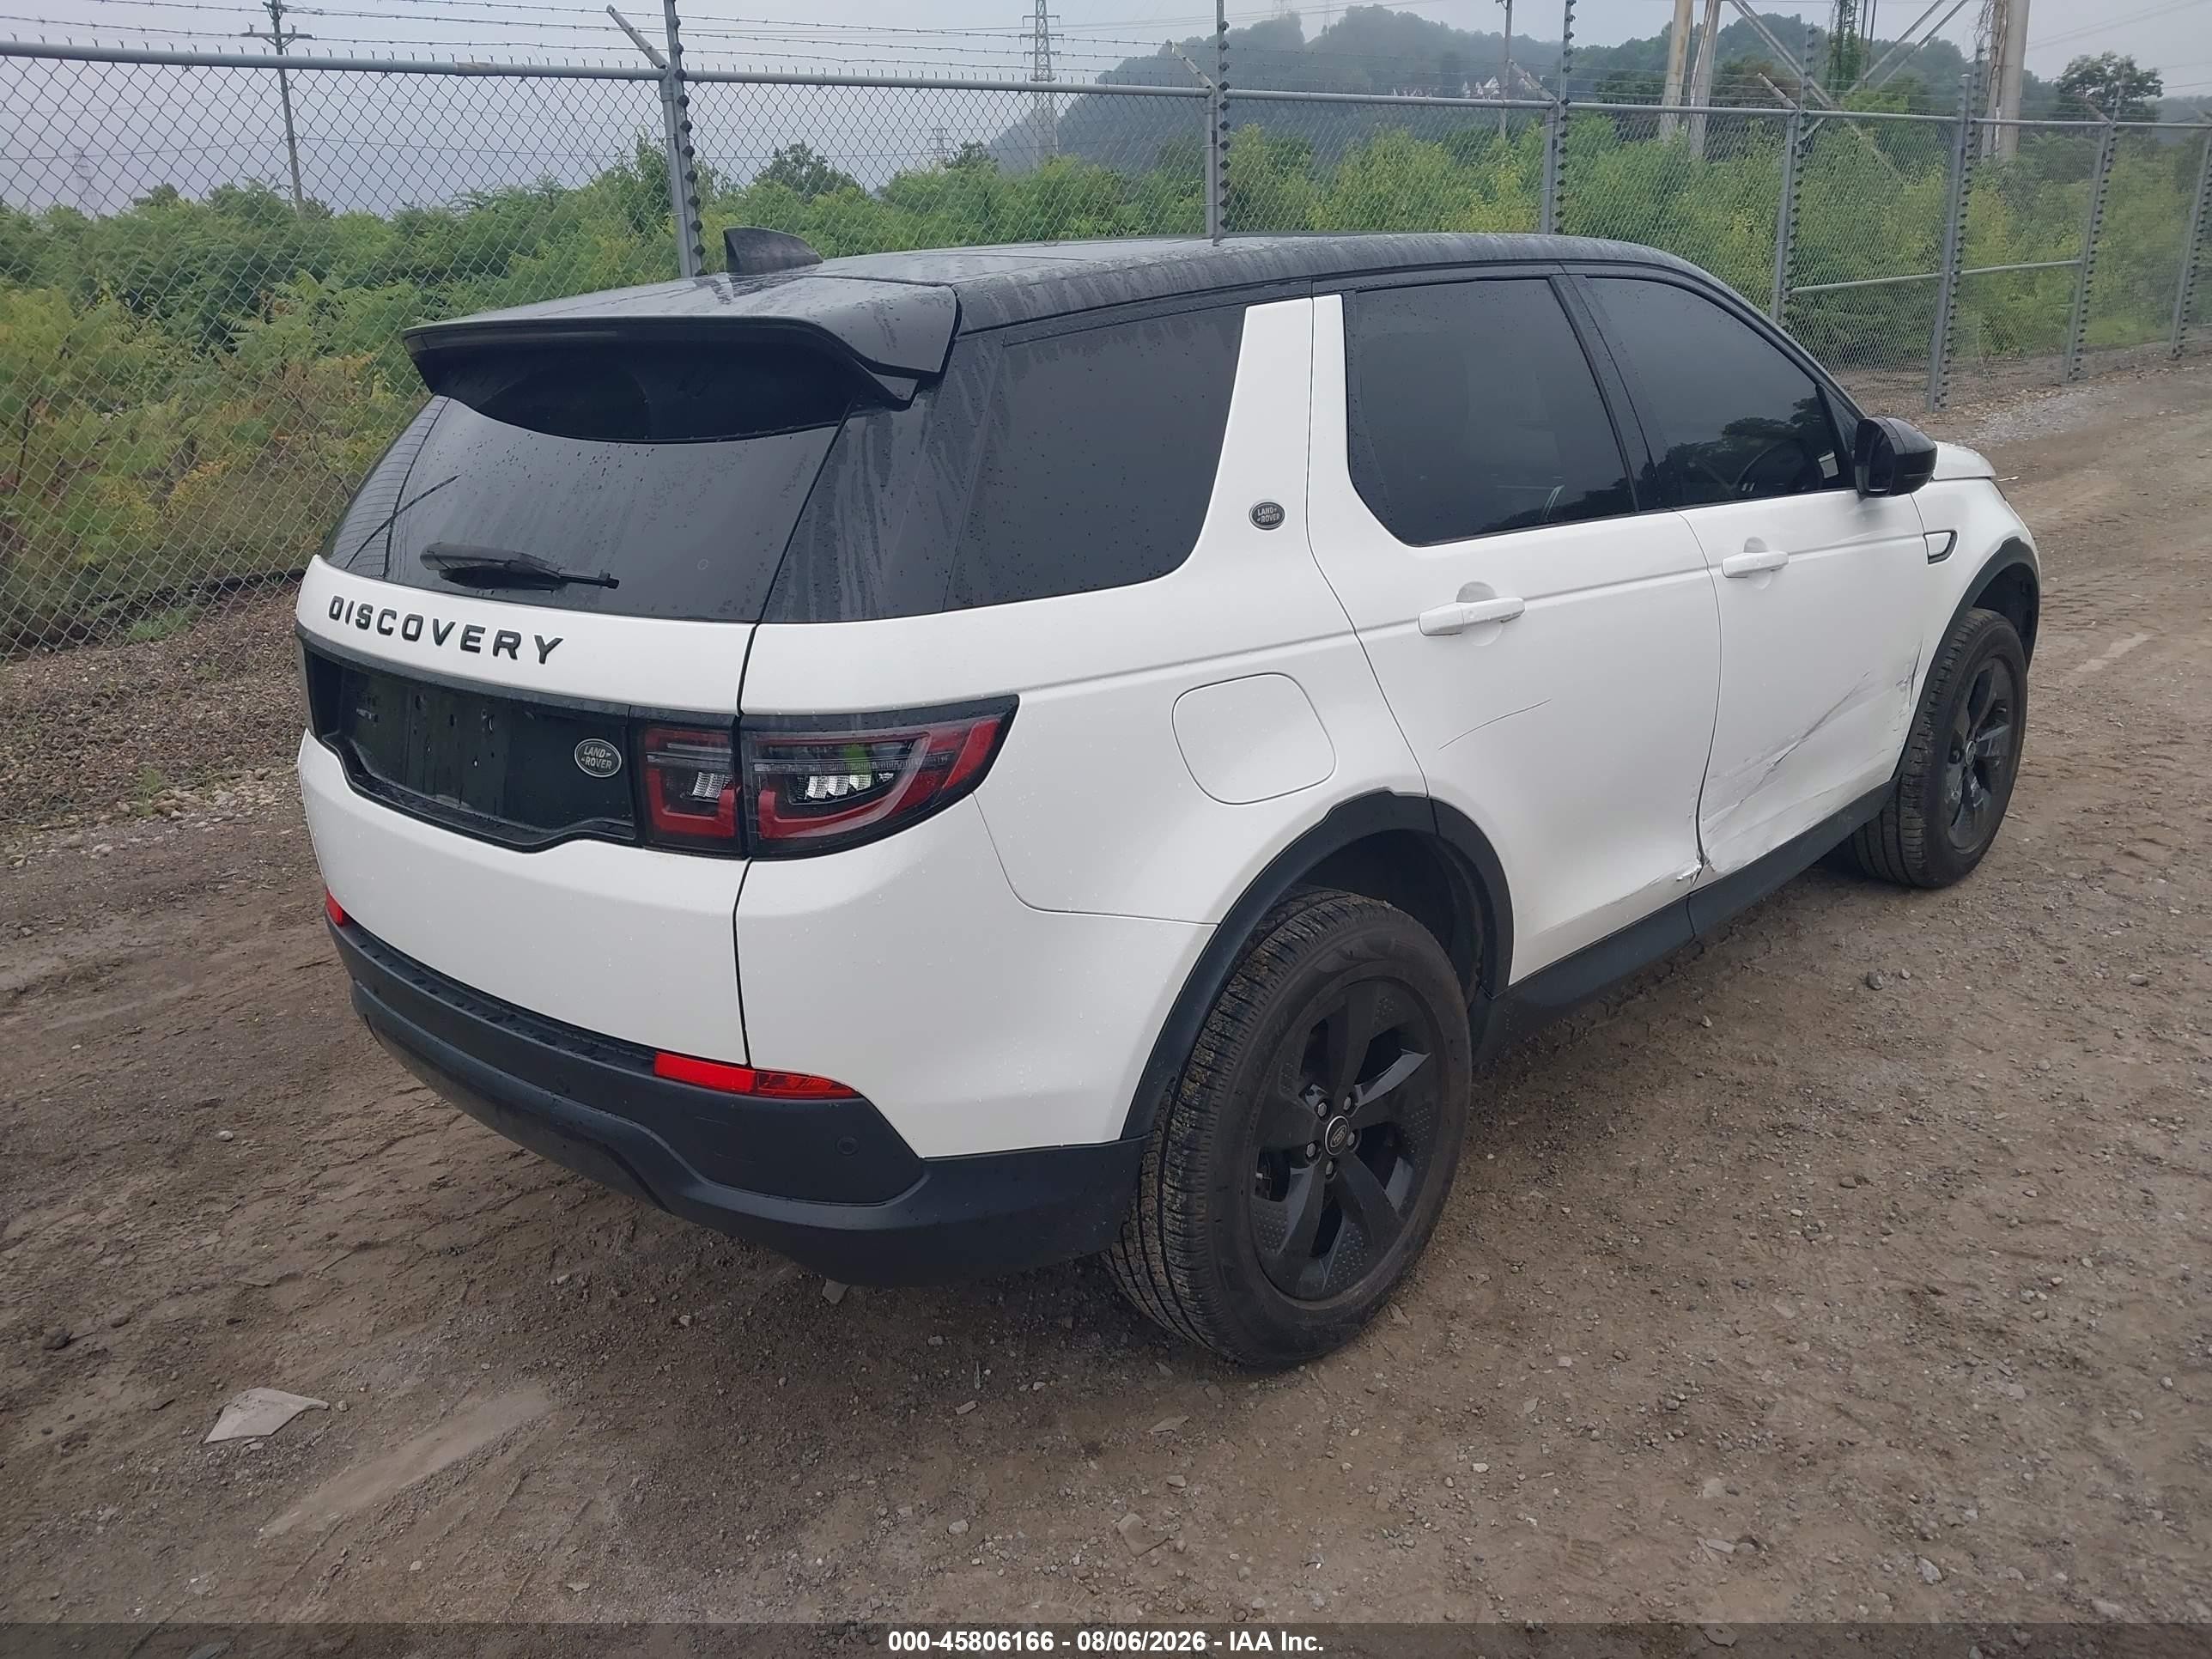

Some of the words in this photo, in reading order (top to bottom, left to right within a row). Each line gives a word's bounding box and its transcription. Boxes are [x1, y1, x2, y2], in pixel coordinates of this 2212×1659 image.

[328, 595, 564, 665] DISCOVERY
[584, 745, 606, 758] LAND
[585, 756, 612, 770] ROVER
